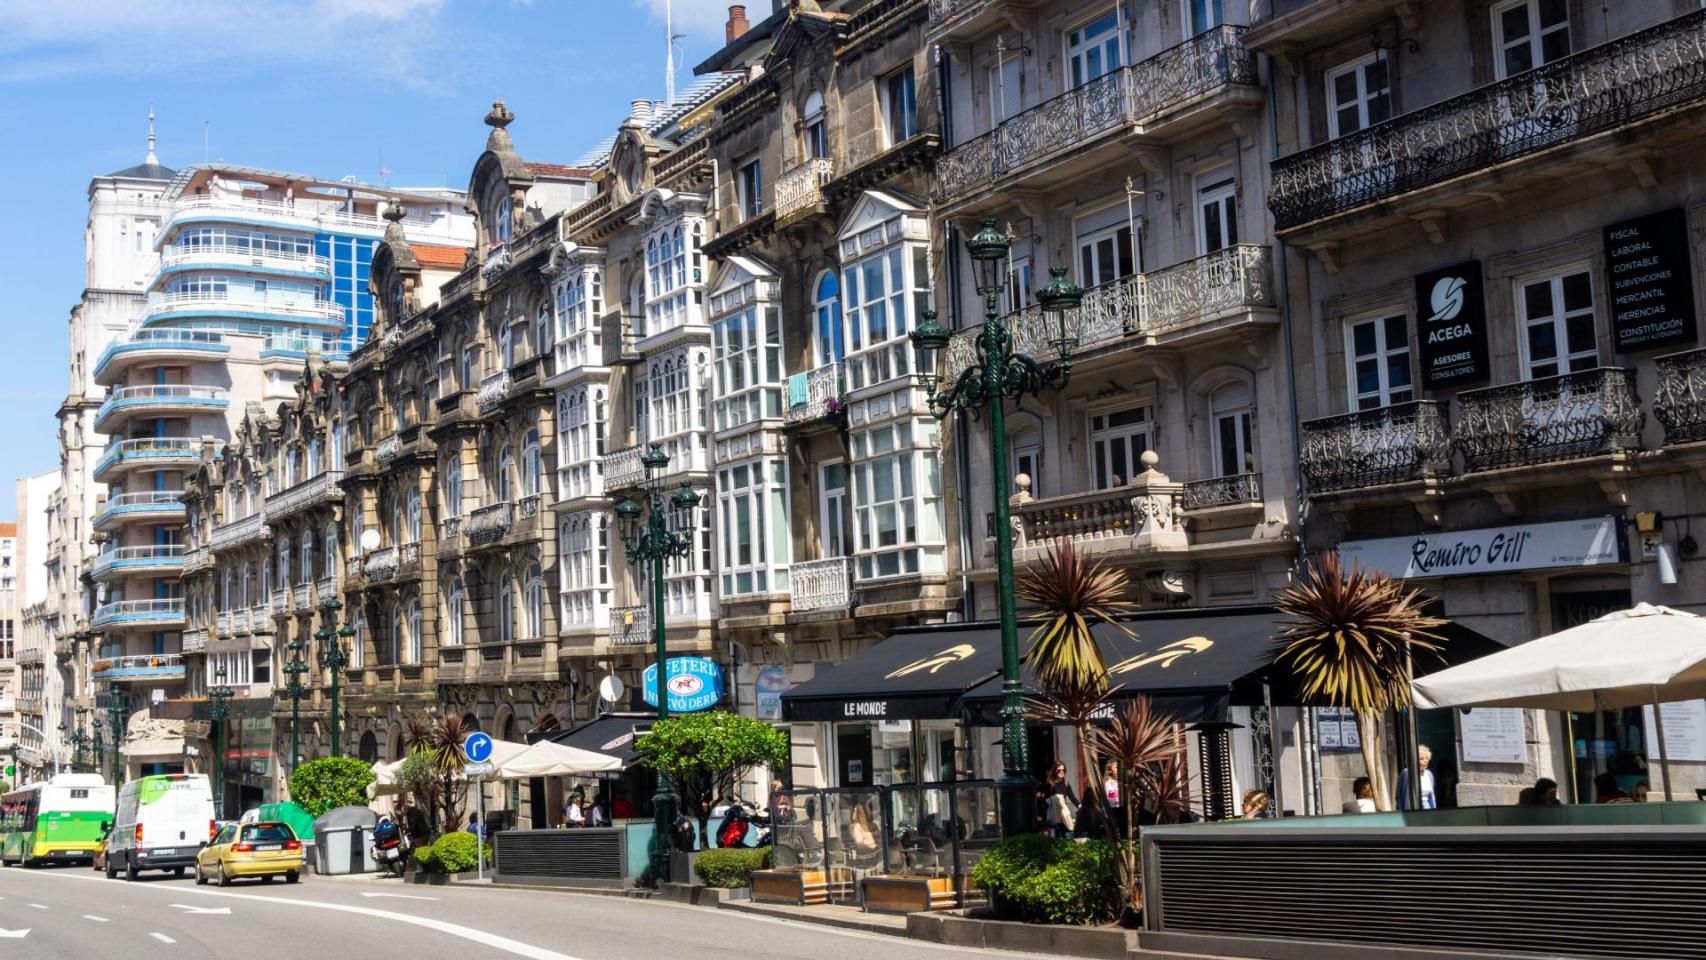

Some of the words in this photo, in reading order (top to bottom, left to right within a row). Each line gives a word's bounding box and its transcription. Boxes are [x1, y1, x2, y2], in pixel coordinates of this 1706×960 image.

[1610, 227, 1639, 241] FISCAL
[1611, 241, 1652, 257] LABORAL
[1613, 256, 1660, 273] CONTABLE
[1615, 270, 1672, 289] SUBVENCIONES
[1616, 289, 1665, 304] MERCANTIL
[1618, 304, 1666, 321] HERENCIAS
[1428, 323, 1473, 344] ACEGA
[1620, 318, 1683, 338] CONSTITUCIÓN
[1433, 351, 1472, 366] ASESORES
[1431, 366, 1475, 380] CONSULTORES
[1411, 538, 1481, 573] Ramiro
[844, 702, 855, 716] LE
[856, 701, 887, 716] MONDE
